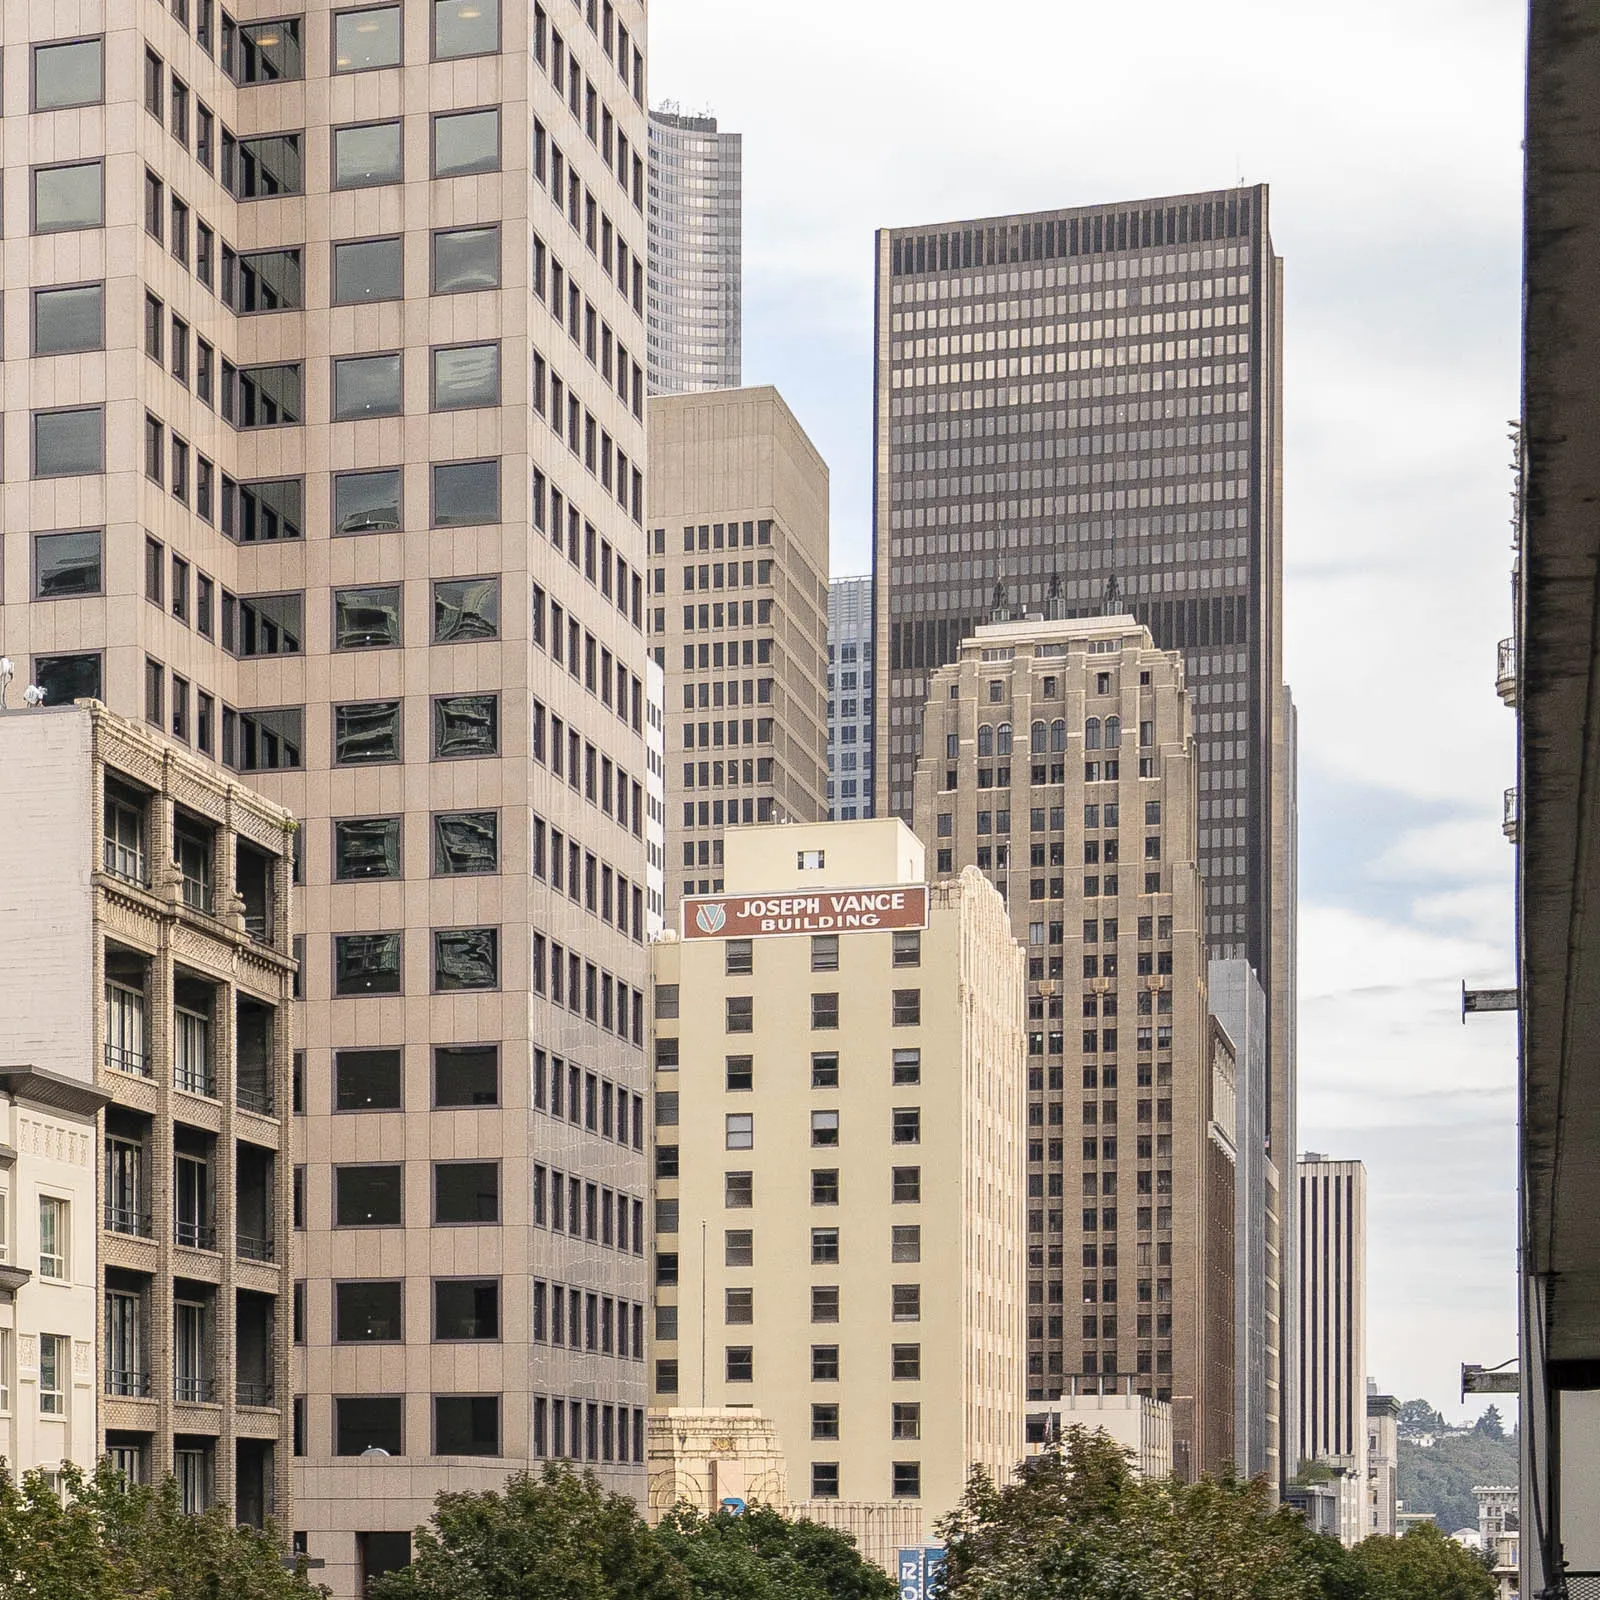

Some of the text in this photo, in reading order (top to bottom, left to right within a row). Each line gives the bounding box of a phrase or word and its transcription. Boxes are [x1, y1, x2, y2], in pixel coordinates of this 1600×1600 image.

[736, 891, 905, 918] JOSEPH VANCE
[760, 913, 881, 931] BUILDING
